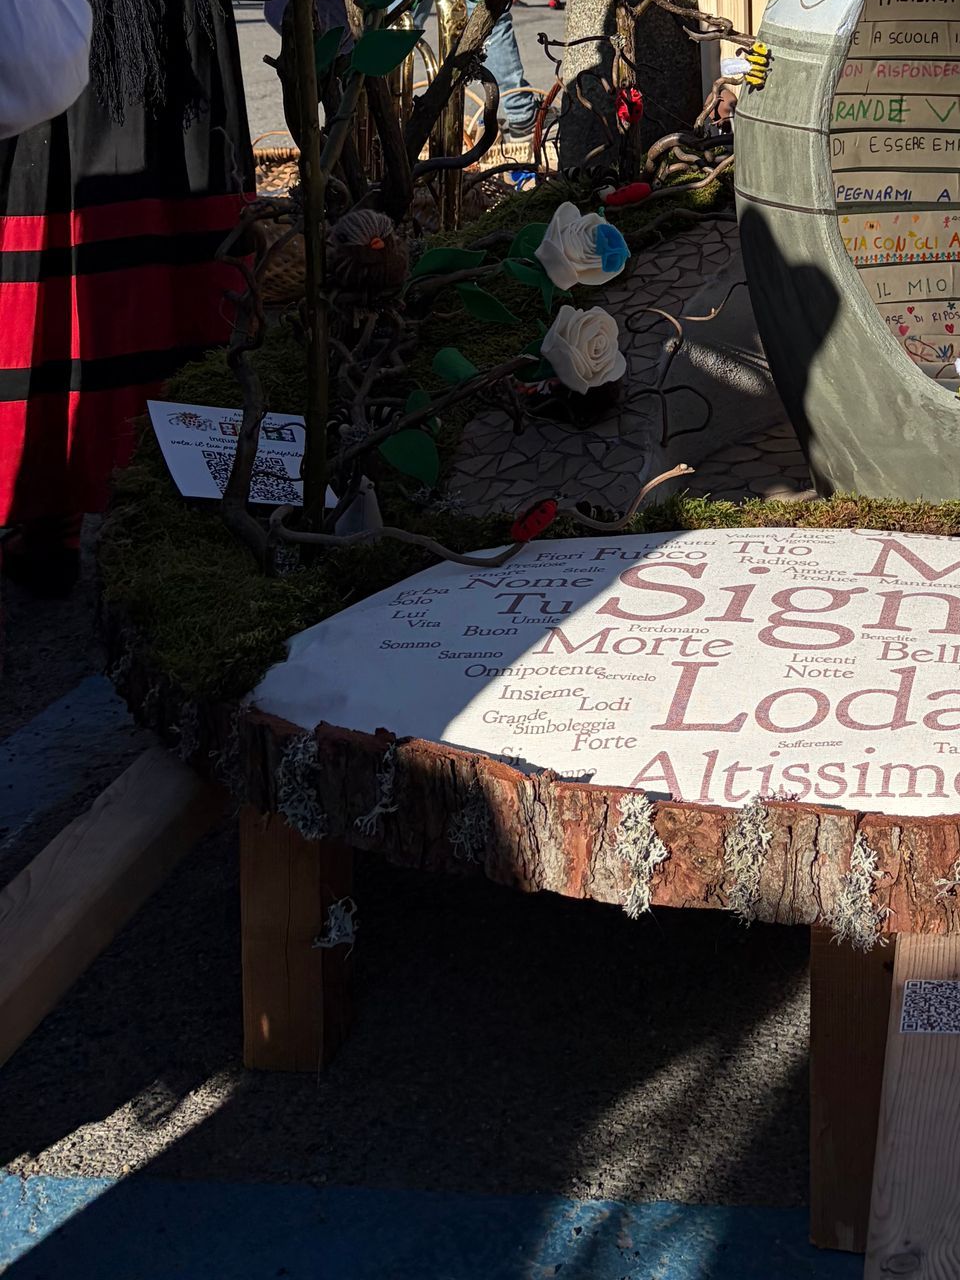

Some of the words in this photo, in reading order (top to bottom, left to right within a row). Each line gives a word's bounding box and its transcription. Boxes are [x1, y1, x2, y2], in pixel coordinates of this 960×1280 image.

[873, 30, 882, 43] A
[888, 31, 939, 45] SCUOLA
[832, 138, 845, 157] DI
[869, 136, 926, 154] ESSERE
[937, 189, 952, 201] A
[873, 235, 906, 253] CON
[914, 236, 938, 250] GLI
[876, 282, 892, 299] IL
[908, 277, 948, 296] MIO
[914, 315, 924, 323] DI
[773, 537, 836, 545] Vigoroso
[789, 532, 836, 540] Luce
[589, 547, 708, 561] Fuoco
[728, 540, 813, 556] Tuo
[535, 551, 586, 562] Fiori
[737, 555, 820, 567] Radioso
[562, 566, 606, 574] Stelle
[782, 566, 848, 576] Amore
[459, 575, 594, 590] Nome
[791, 573, 859, 583] Produce
[388, 596, 433, 607] Solo
[494, 592, 575, 615] Tu
[391, 609, 430, 619] Lui
[511, 615, 561, 625] Umile
[407, 619, 442, 628] Vita
[628, 624, 710, 635] Perdonano
[462, 625, 519, 637] Buon
[532, 626, 734, 658] Morte
[860, 632, 918, 643] Benedite
[378, 639, 442, 650] Sommo
[437, 650, 504, 660] Saranno
[791, 652, 857, 666] Lucenti
[464, 663, 607, 680] Onnipotente
[597, 670, 657, 683] Servitelo
[783, 664, 855, 680] Notte
[498, 684, 585, 702] Insieme
[576, 696, 633, 712] Lodi
[482, 708, 549, 725] Grande
[512, 717, 617, 735] Simboleggia
[570, 732, 638, 753] Forte
[777, 739, 844, 750] Sofferenze
